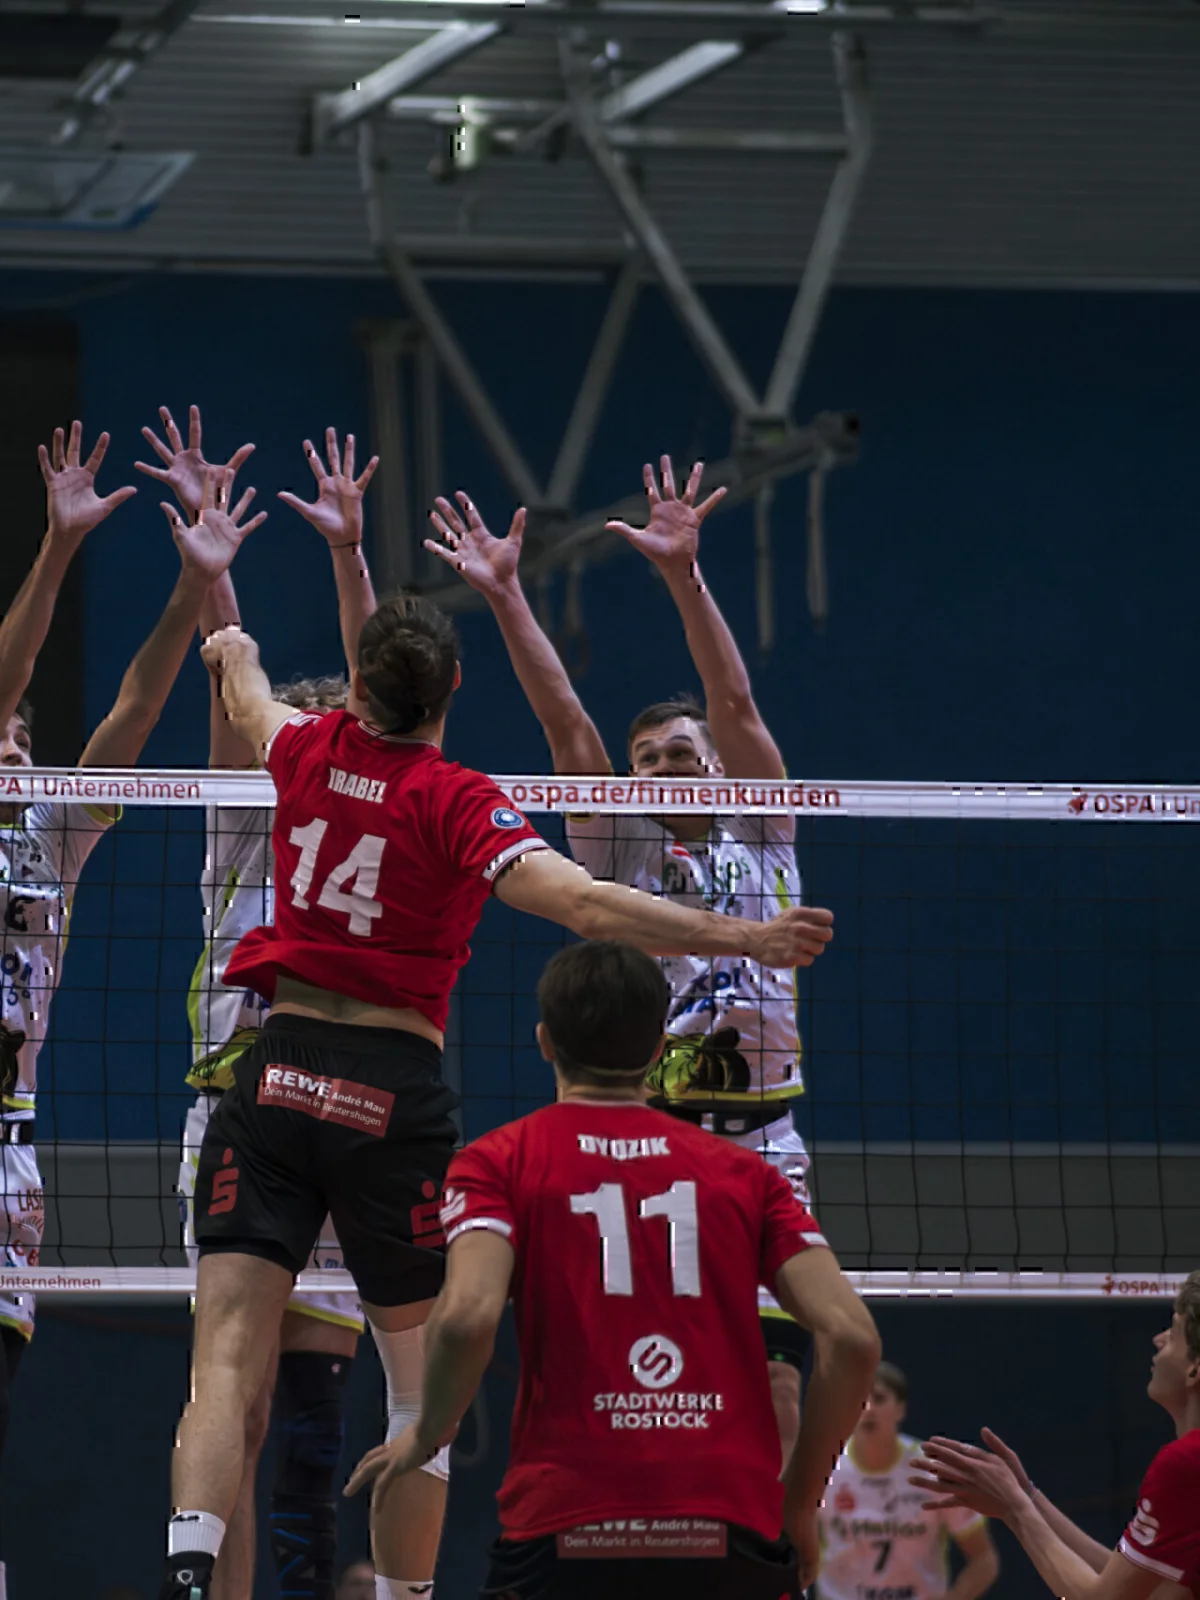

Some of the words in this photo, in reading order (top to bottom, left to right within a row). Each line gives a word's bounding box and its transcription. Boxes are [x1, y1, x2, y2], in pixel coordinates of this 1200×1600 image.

[43, 777, 201, 799] Unternehmen
[511, 781, 841, 809] ospa.de/firmenkunden
[1094, 794, 1155, 814] OSPA
[289, 817, 387, 937] 14
[266, 1069, 332, 1099] REWE
[332, 1091, 361, 1105] André
[363, 1099, 386, 1114] Mau
[264, 1087, 282, 1096] Dein
[285, 1090, 312, 1106] Markt
[312, 1100, 321, 1109] in
[322, 1102, 382, 1126] Reutershagen
[569, 1181, 702, 1298] 11
[1119, 1281, 1160, 1294] OSPA
[593, 1392, 724, 1412] STADTWERKE
[611, 1411, 708, 1430] ROSTOCK
[565, 1535, 588, 1547] Dein
[590, 1535, 626, 1547] Markt
[630, 1536, 641, 1546] in
[645, 1535, 720, 1548] Reutershagen
[868, 1540, 893, 1573] 7
